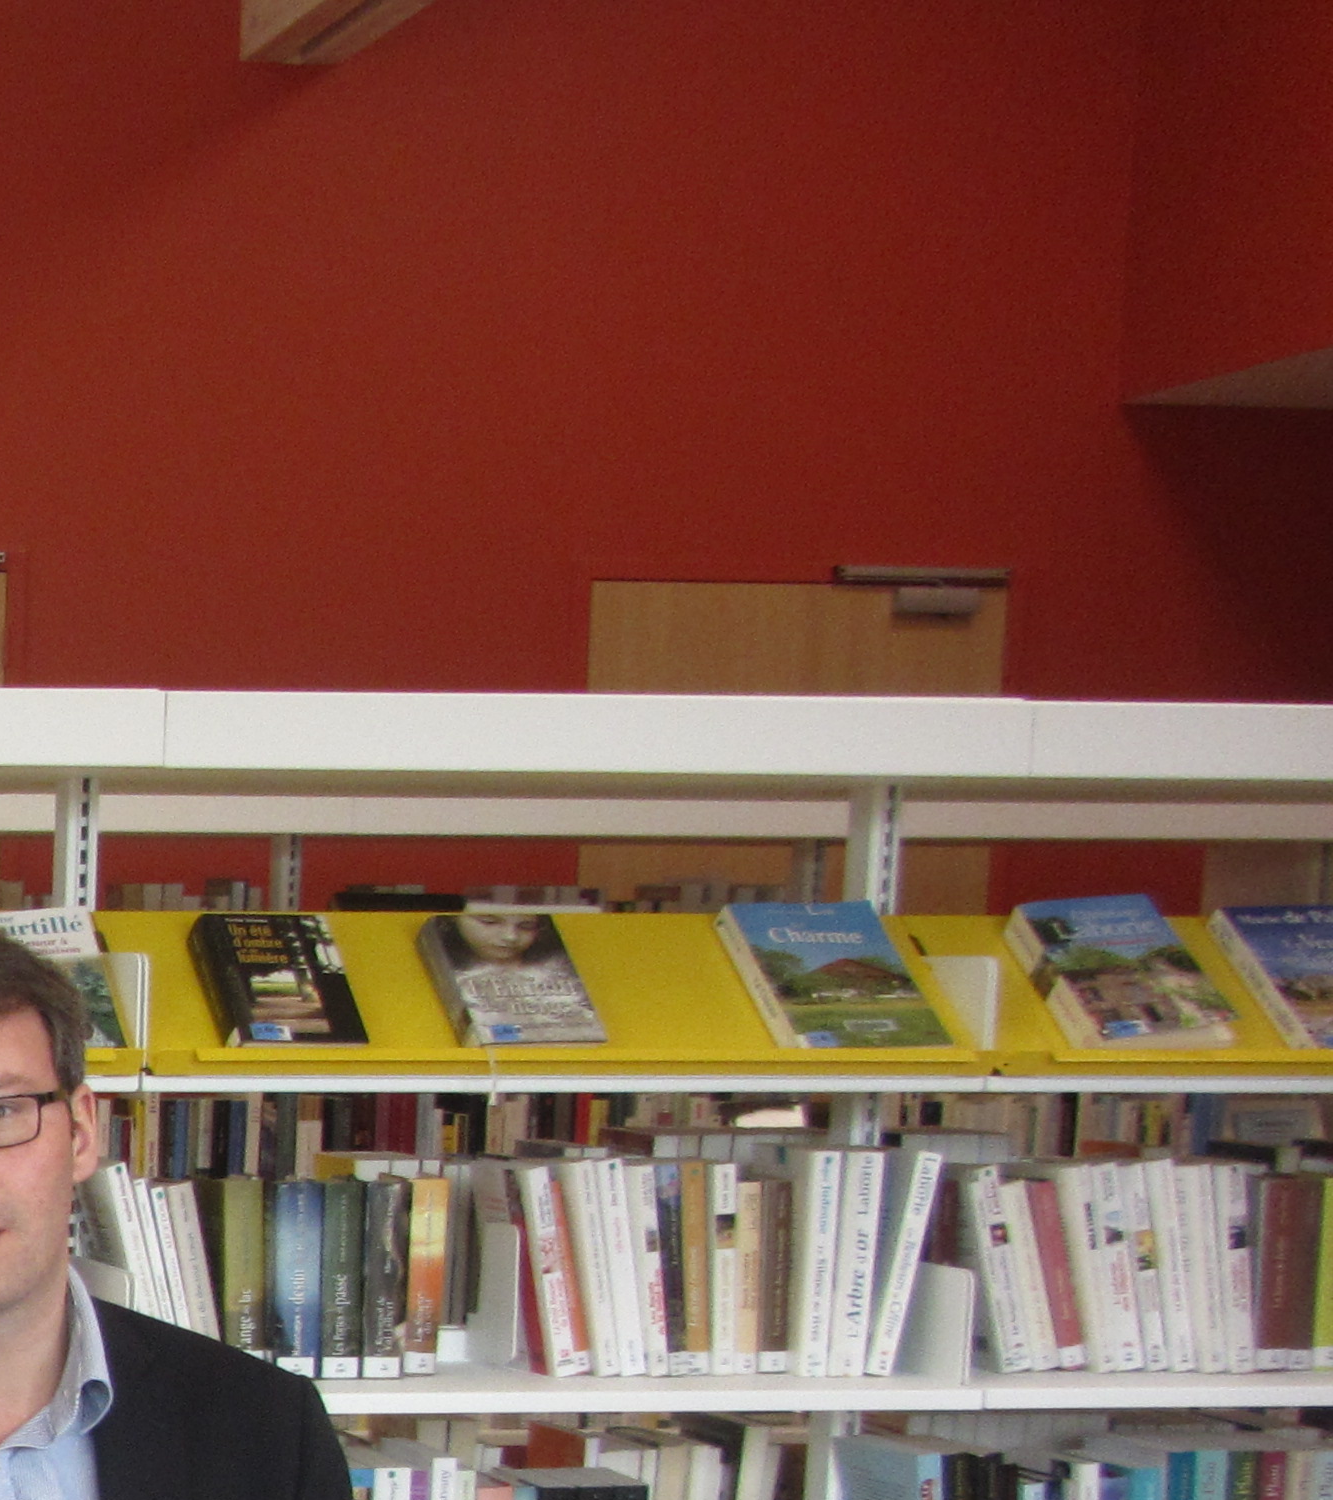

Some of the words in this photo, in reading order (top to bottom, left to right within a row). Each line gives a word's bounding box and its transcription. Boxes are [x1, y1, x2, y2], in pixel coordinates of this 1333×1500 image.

[8, 914, 82, 936] rtillé
[769, 927, 863, 944] Charme
[857, 1156, 875, 1215] Laborie
[910, 1157, 939, 1216] Laborie
[238, 1288, 251, 1303] lac
[287, 1269, 306, 1305] destin
[331, 1273, 351, 1306] passé
[236, 1316, 256, 1350] 'ange
[1265, 1464, 1280, 1497] Plain
